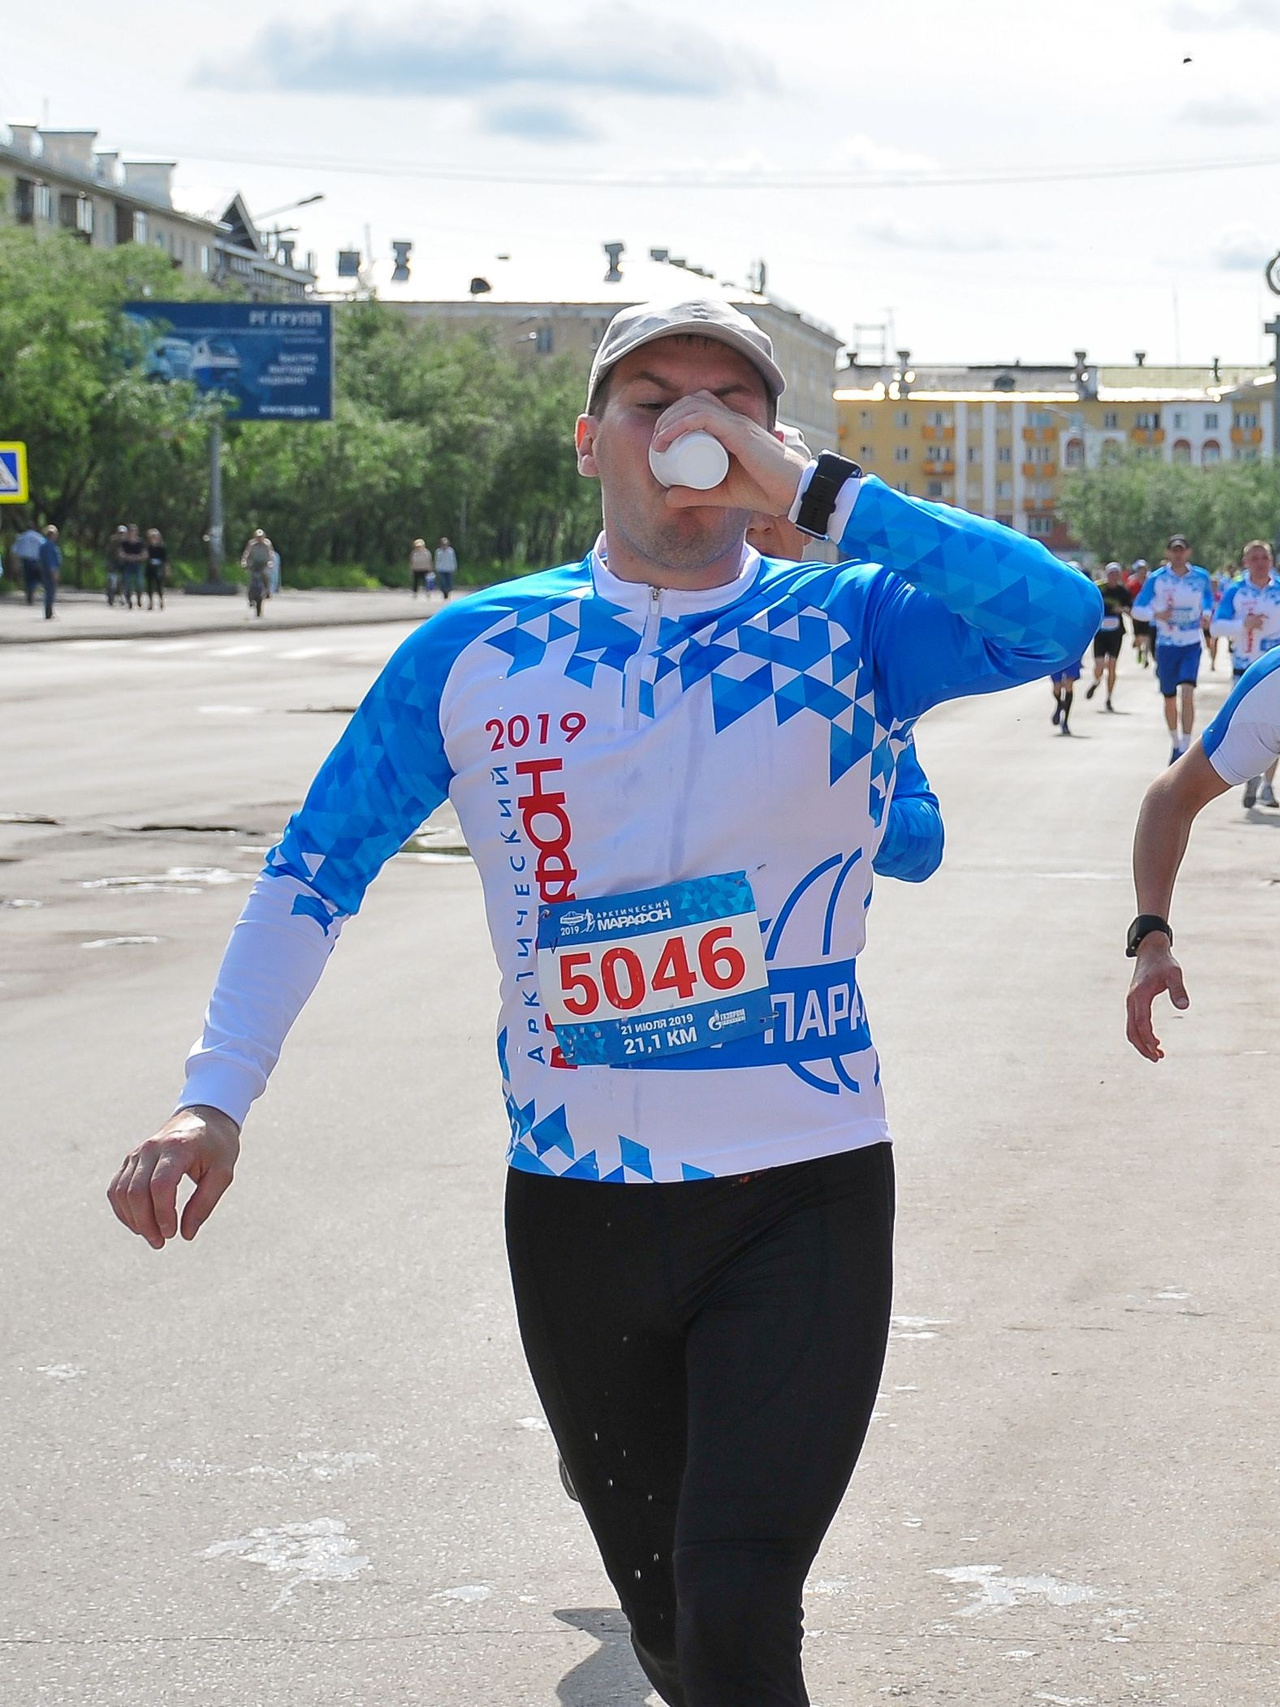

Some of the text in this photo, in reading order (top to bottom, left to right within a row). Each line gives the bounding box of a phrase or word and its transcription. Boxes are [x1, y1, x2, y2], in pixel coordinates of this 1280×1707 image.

[485, 711, 587, 752] 2019
[596, 900, 670, 918] АРКТИЧЕСКИЙ
[597, 907, 672, 931] МАРАФОН
[560, 926, 580, 936] 2019
[559, 926, 747, 1016] 5046
[620, 1013, 694, 1035] 21 ИЮЛЯ 2019
[623, 1026, 698, 1055] 21,1 КМ
